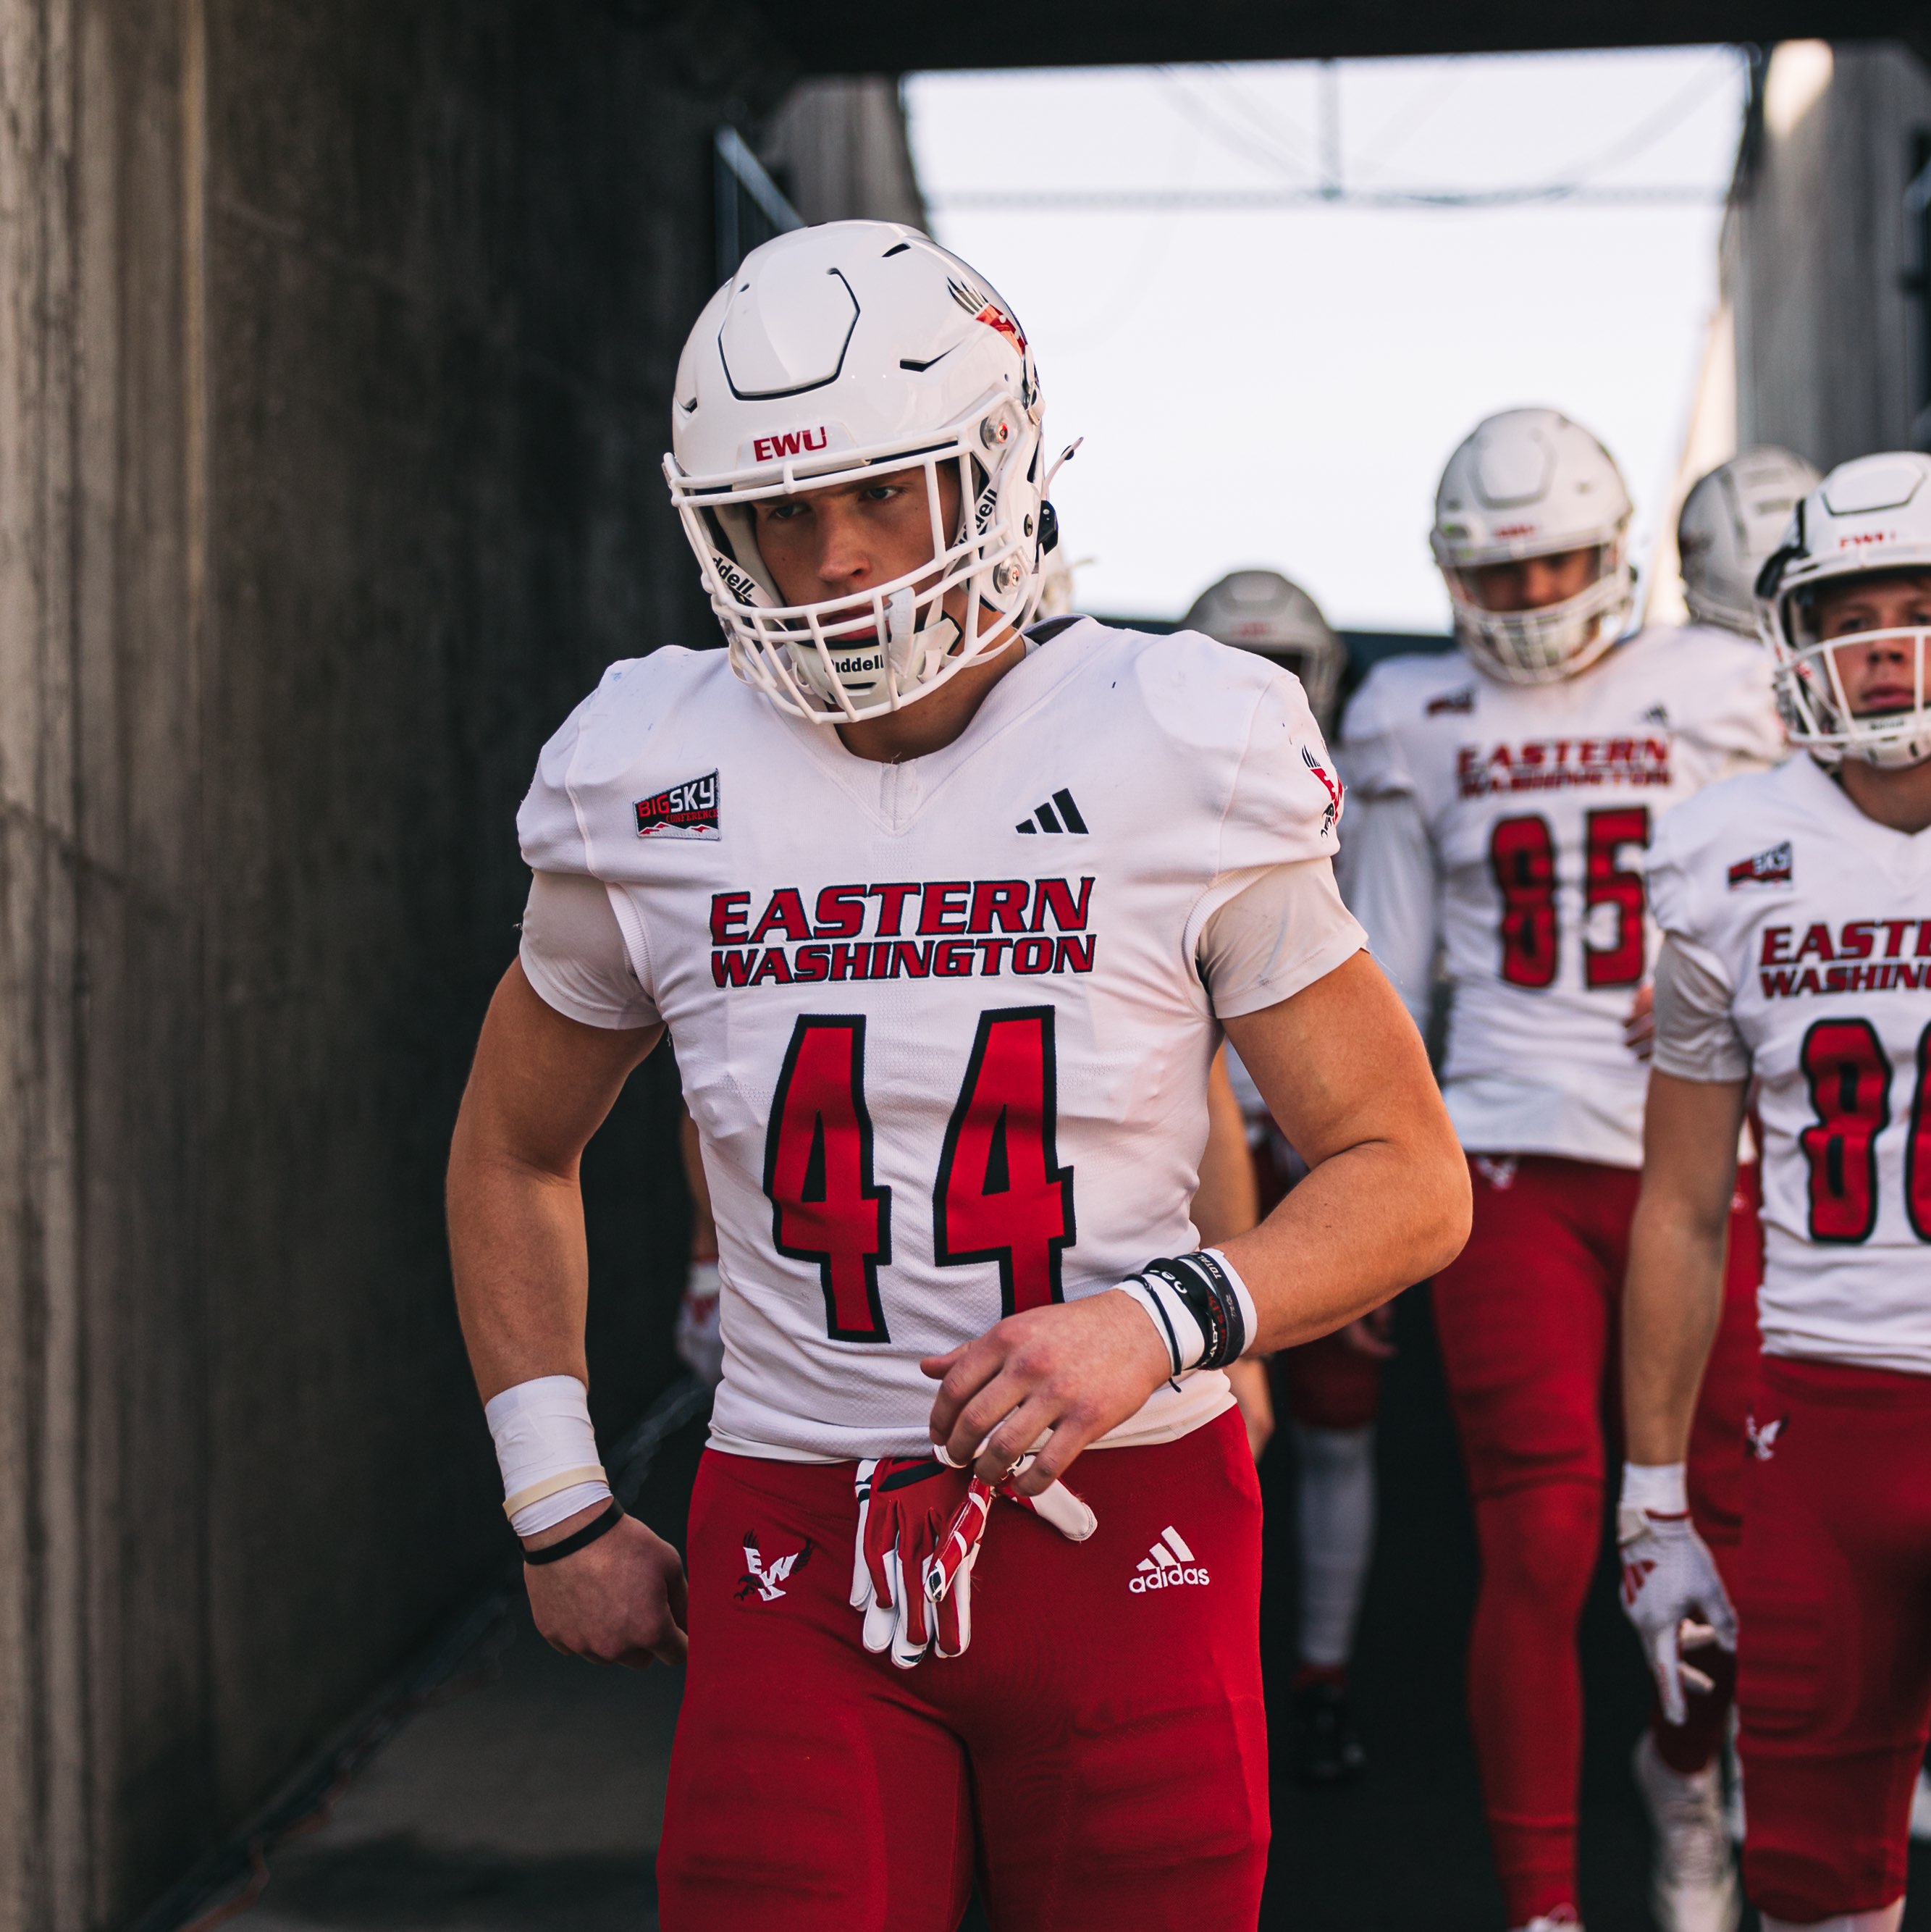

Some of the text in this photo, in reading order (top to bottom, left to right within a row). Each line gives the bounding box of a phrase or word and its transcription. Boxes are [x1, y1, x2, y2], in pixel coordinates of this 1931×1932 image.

[753, 426, 827, 462] EWU
[710, 876, 1096, 946] EASTERN
[1490, 805, 1652, 989] 85
[711, 934, 1097, 988] WASHINGTON
[1759, 962, 1931, 999] WASHIN
[762, 1004, 1077, 1344] 44
[1197, 1255, 1223, 1280] TOTAL
[1128, 1563, 1210, 1593] adidas
